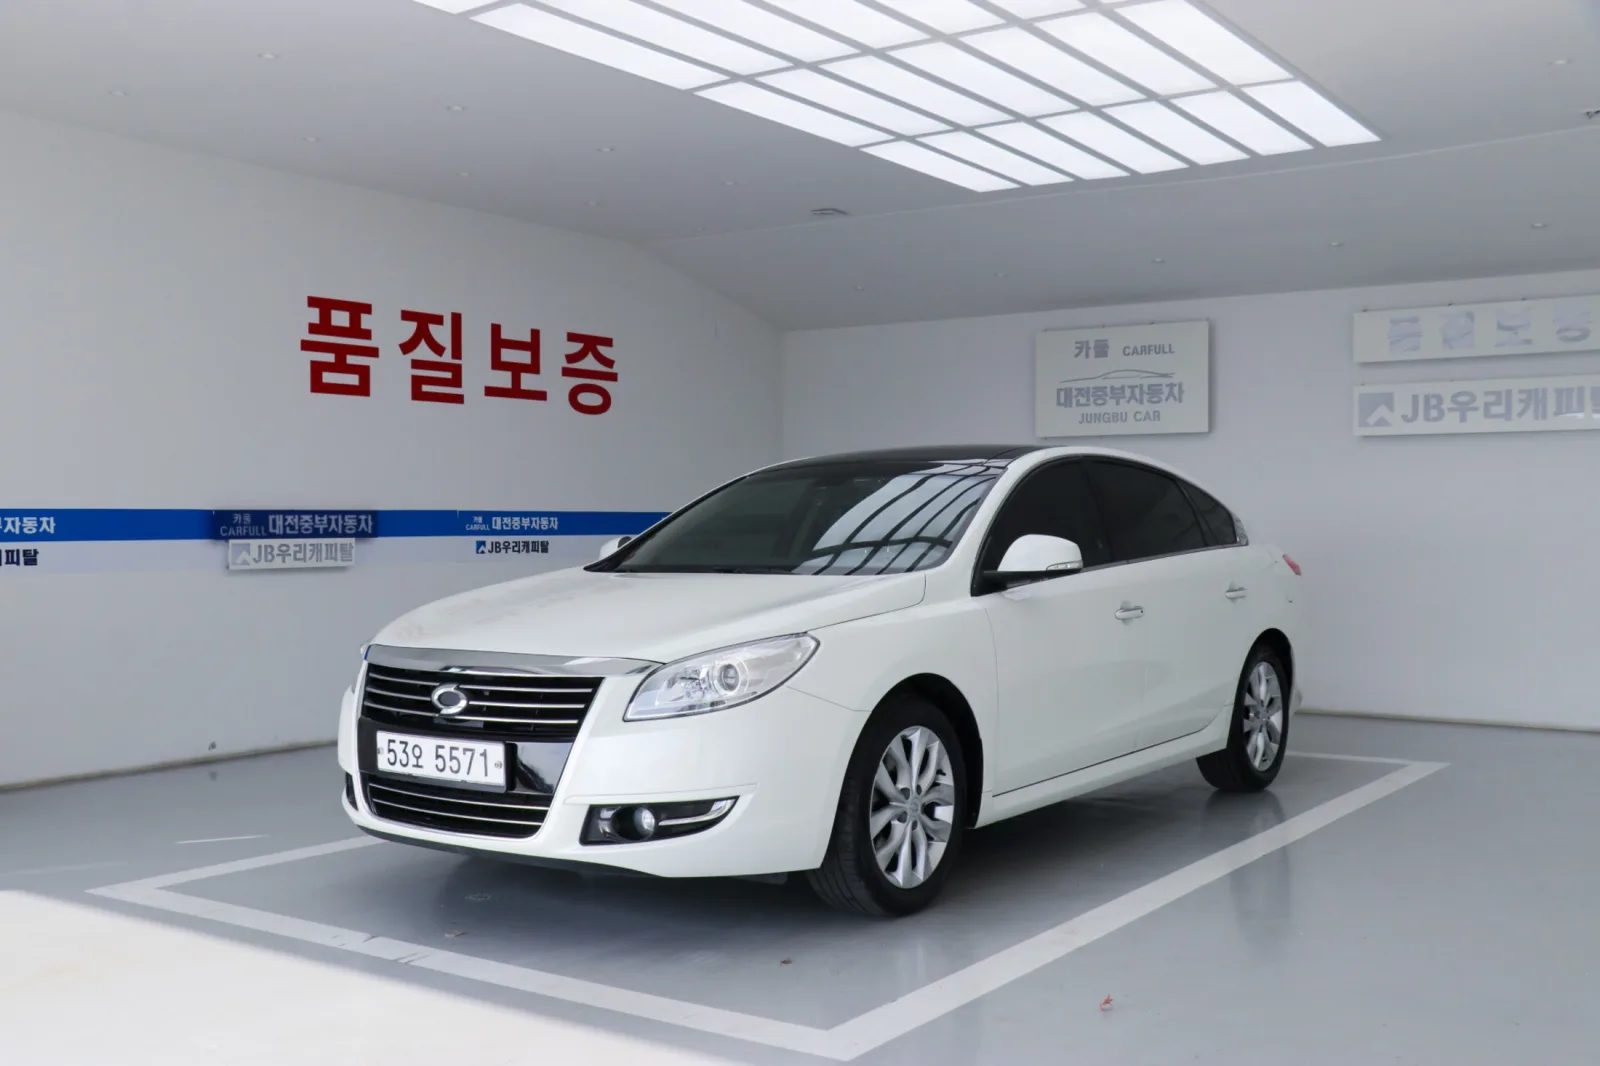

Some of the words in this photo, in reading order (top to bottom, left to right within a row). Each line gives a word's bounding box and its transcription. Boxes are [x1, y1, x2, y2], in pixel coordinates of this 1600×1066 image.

[300, 295, 619, 416] 품질보증
[1122, 343, 1175, 357] CARFULL
[1056, 382, 1184, 408] 대전중부자동차
[1078, 412, 1128, 424] JUNGBU
[1133, 410, 1161, 422] CAR
[0, 516, 56, 534] 자동차
[219, 525, 267, 537] CARFULL
[268, 514, 373, 534] 대전중부자동차
[491, 516, 559, 530] 대전중부자동차
[252, 542, 354, 563] JB우리캐피탈
[487, 540, 549, 554] JB우리캐피탈
[0, 548, 39, 566] 피탈
[434, 744, 489, 778] 5571
